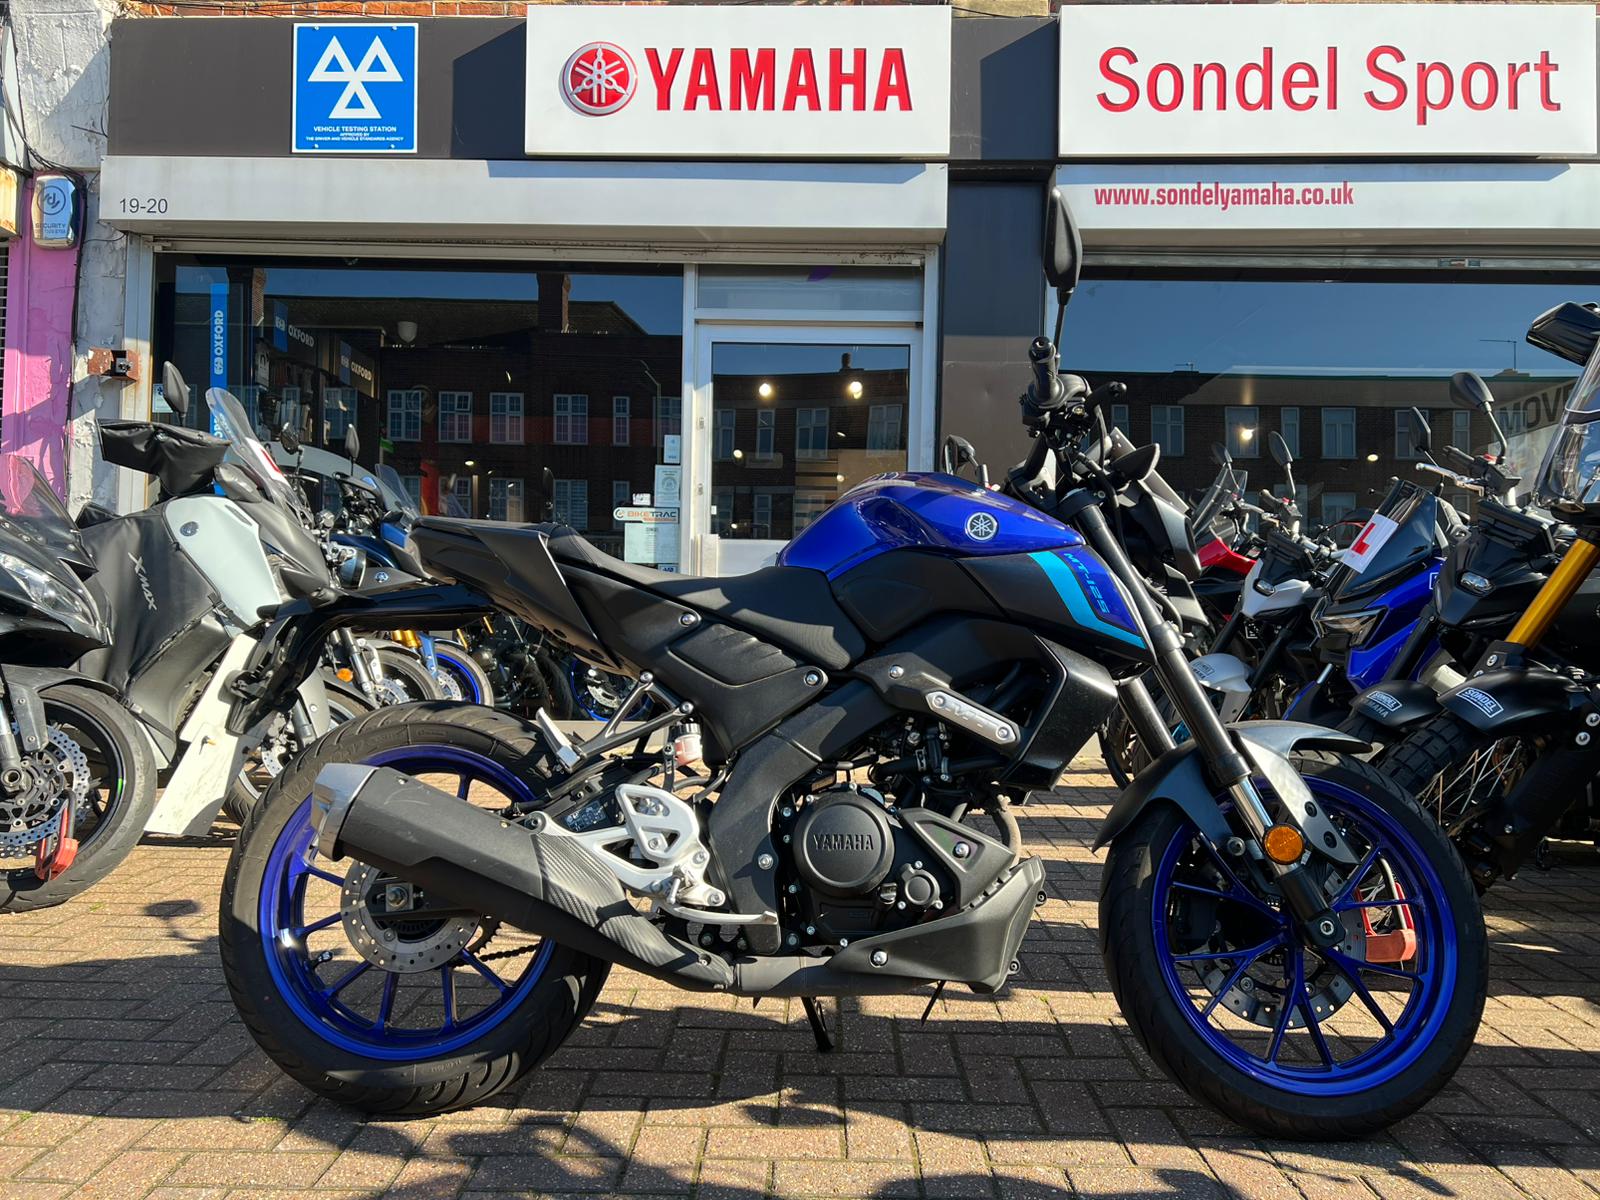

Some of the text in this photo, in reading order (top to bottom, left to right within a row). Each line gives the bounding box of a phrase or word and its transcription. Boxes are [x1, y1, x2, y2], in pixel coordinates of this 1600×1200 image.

[644, 47, 914, 111] YAMAHA
[1096, 45, 1561, 126] Sondel Sport
[118, 197, 169, 214] 19-20
[1094, 181, 1354, 211] www.sondelyamaha.co.uk
[214, 310, 224, 356] OXFORD
[288, 324, 315, 348] OXFORD
[351, 361, 373, 382] OXFORD
[1351, 522, 1376, 556] L
[1063, 553, 1111, 614] MT-125
[1465, 688, 1498, 712] SONDEL
[813, 833, 875, 851] YAMAHA
